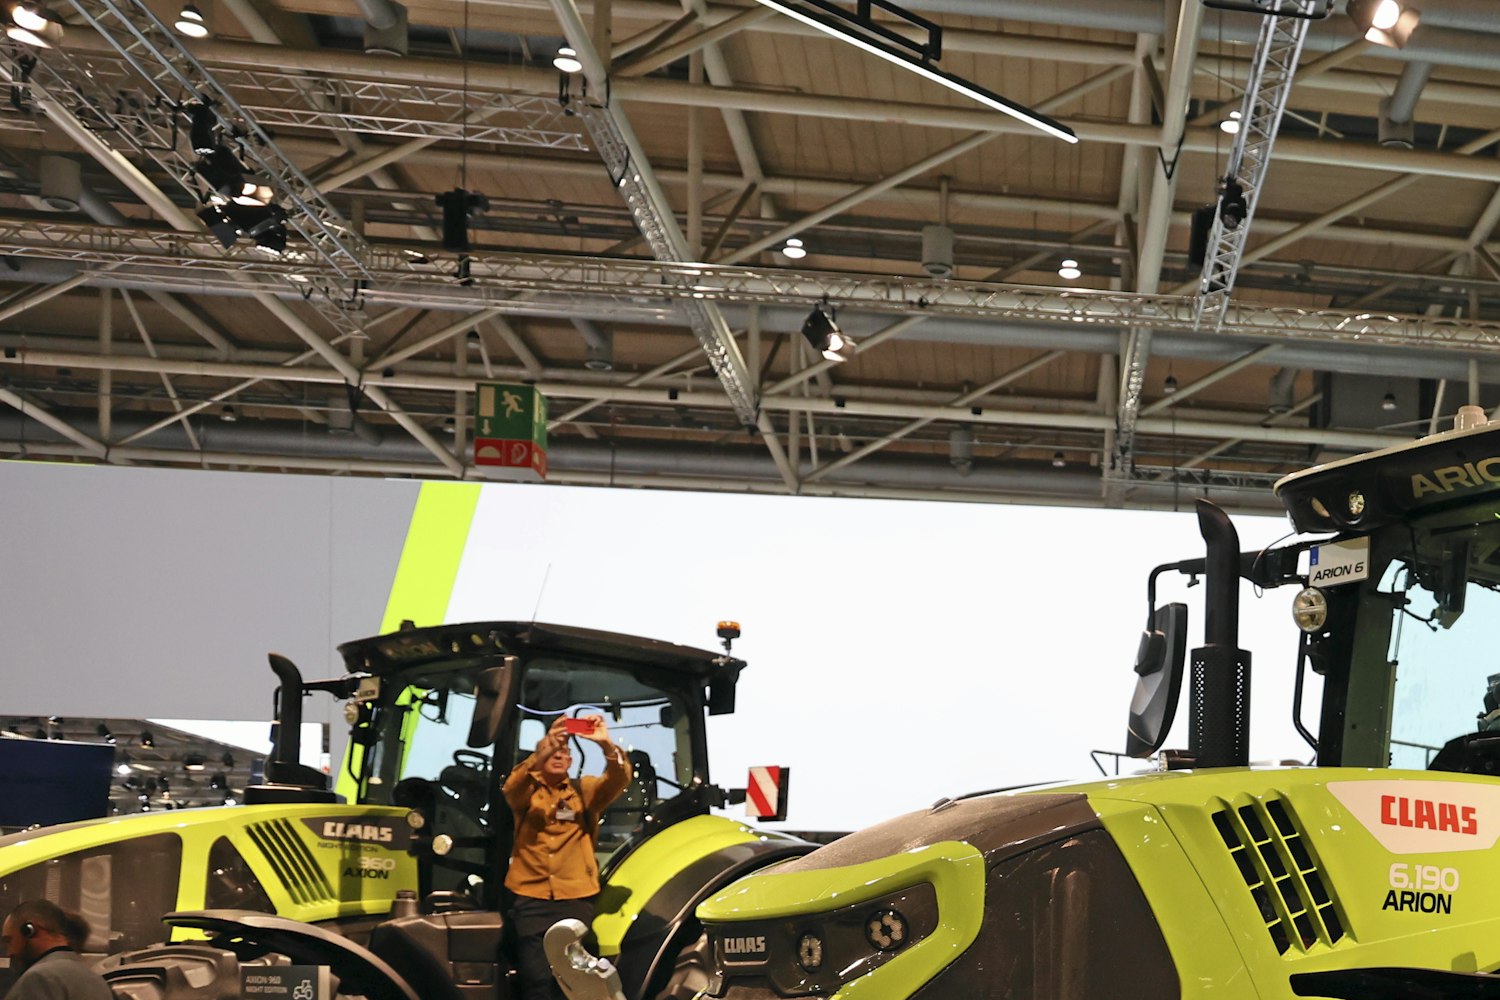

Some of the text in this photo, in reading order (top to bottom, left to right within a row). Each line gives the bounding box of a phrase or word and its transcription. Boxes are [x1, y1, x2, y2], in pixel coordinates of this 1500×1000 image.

[1313, 561, 1365, 581] ARION 6
[1381, 795, 1477, 835] CLAAS
[323, 821, 393, 842] CLAAS
[343, 867, 389, 880] AXION
[1389, 863, 1459, 892] 6.190
[1382, 890, 1452, 914] ARION
[724, 936, 766, 953] CLAAS
